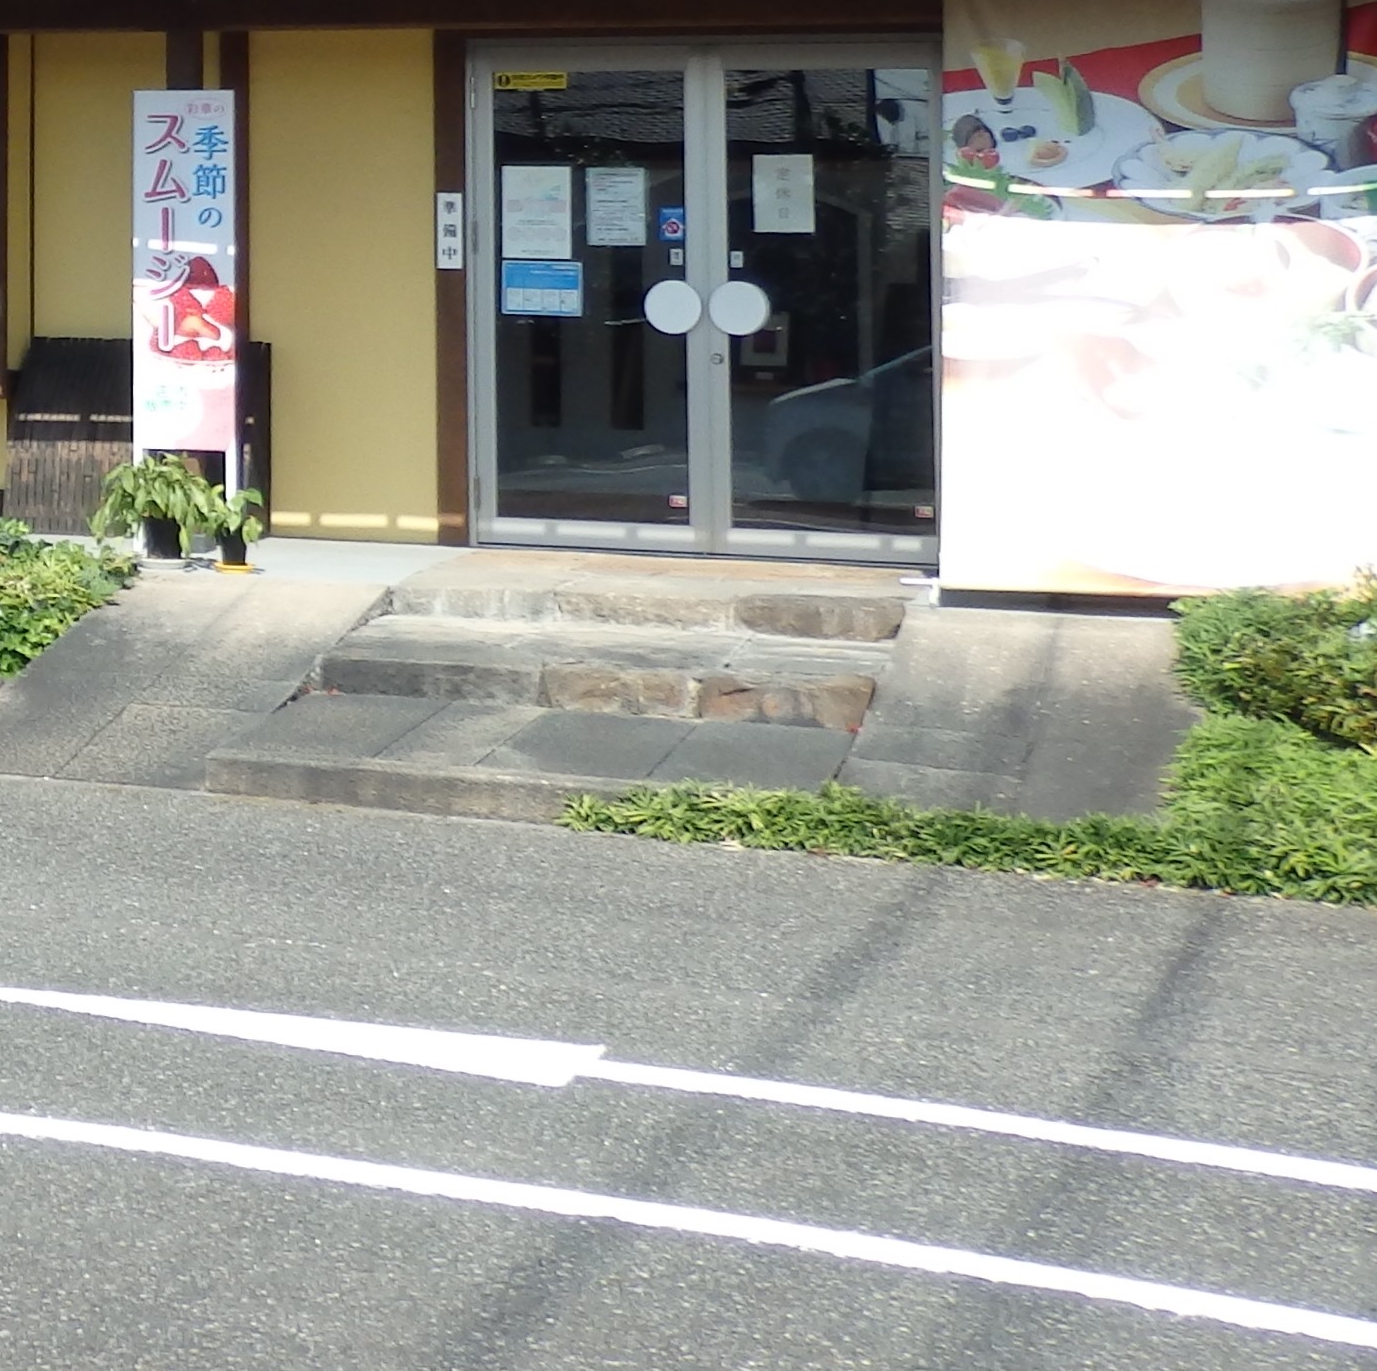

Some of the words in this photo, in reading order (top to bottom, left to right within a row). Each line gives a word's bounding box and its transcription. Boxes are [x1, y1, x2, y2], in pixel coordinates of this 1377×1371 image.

[144, 113, 190, 352] スムージー
[192, 124, 229, 228] 季節の
